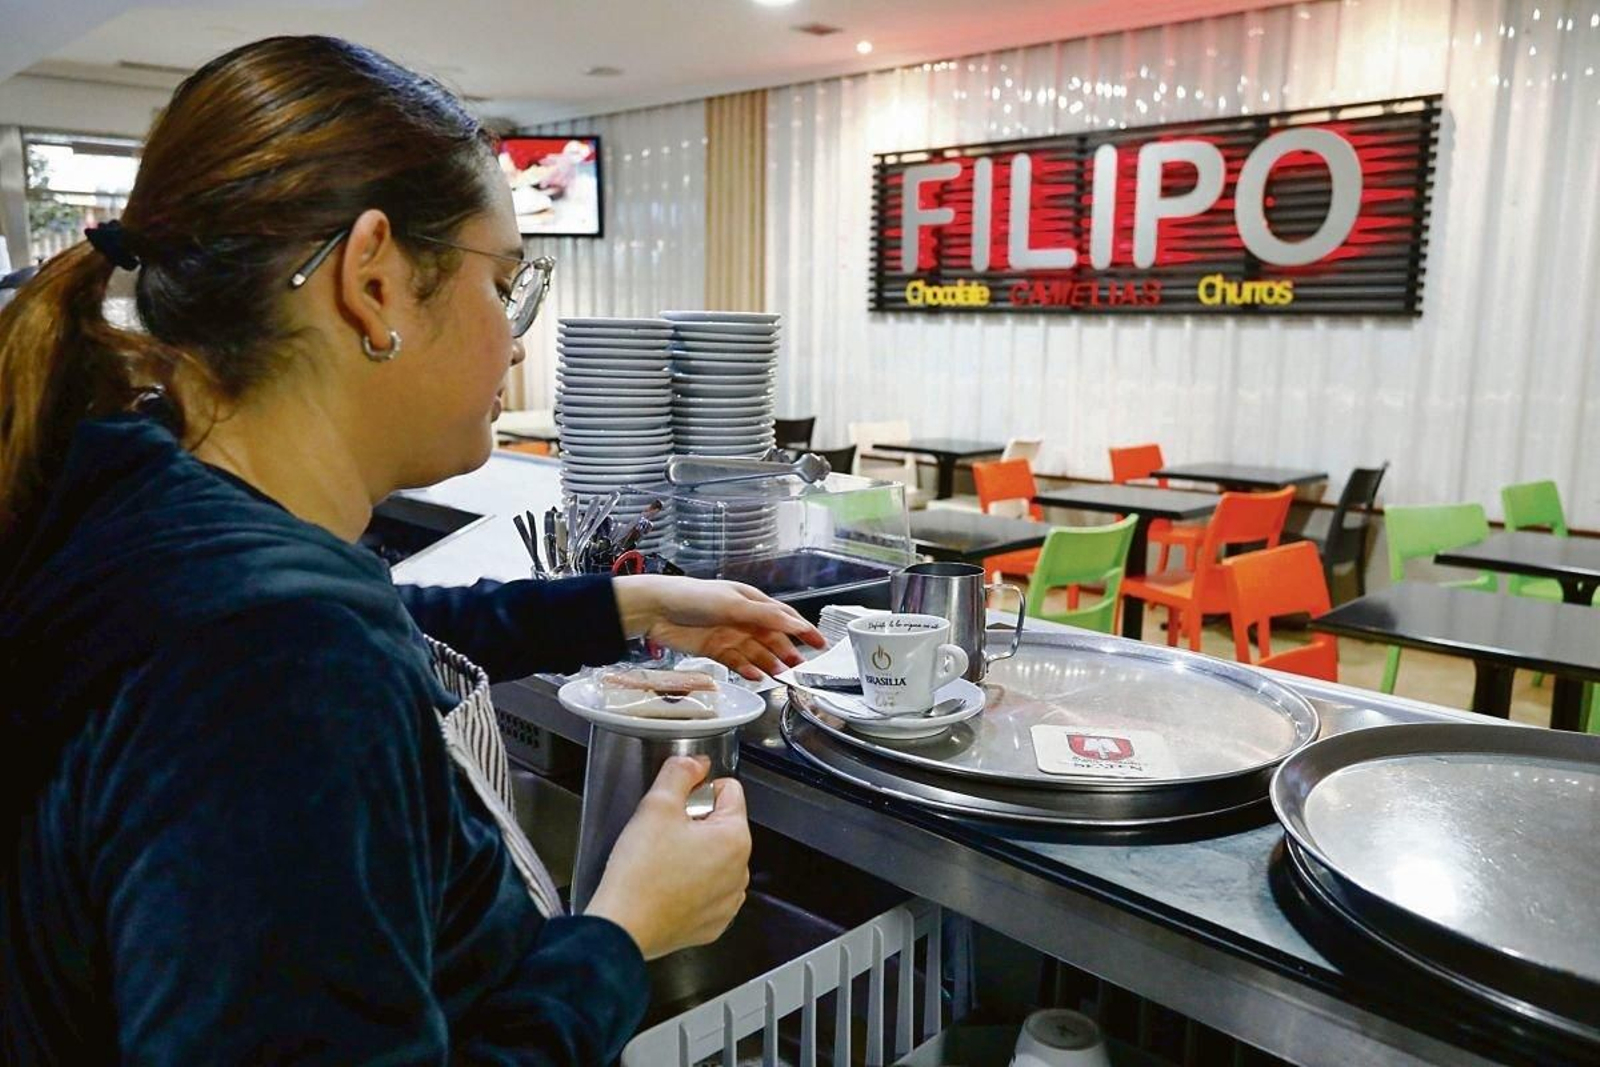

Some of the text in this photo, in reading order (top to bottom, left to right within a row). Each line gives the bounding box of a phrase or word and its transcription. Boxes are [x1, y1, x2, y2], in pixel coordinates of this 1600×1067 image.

[902, 127, 1363, 273] FILIPO
[905, 280, 990, 306] Chocolate
[1008, 278, 1163, 308] CAMELIAS
[1197, 273, 1294, 305] Churros
